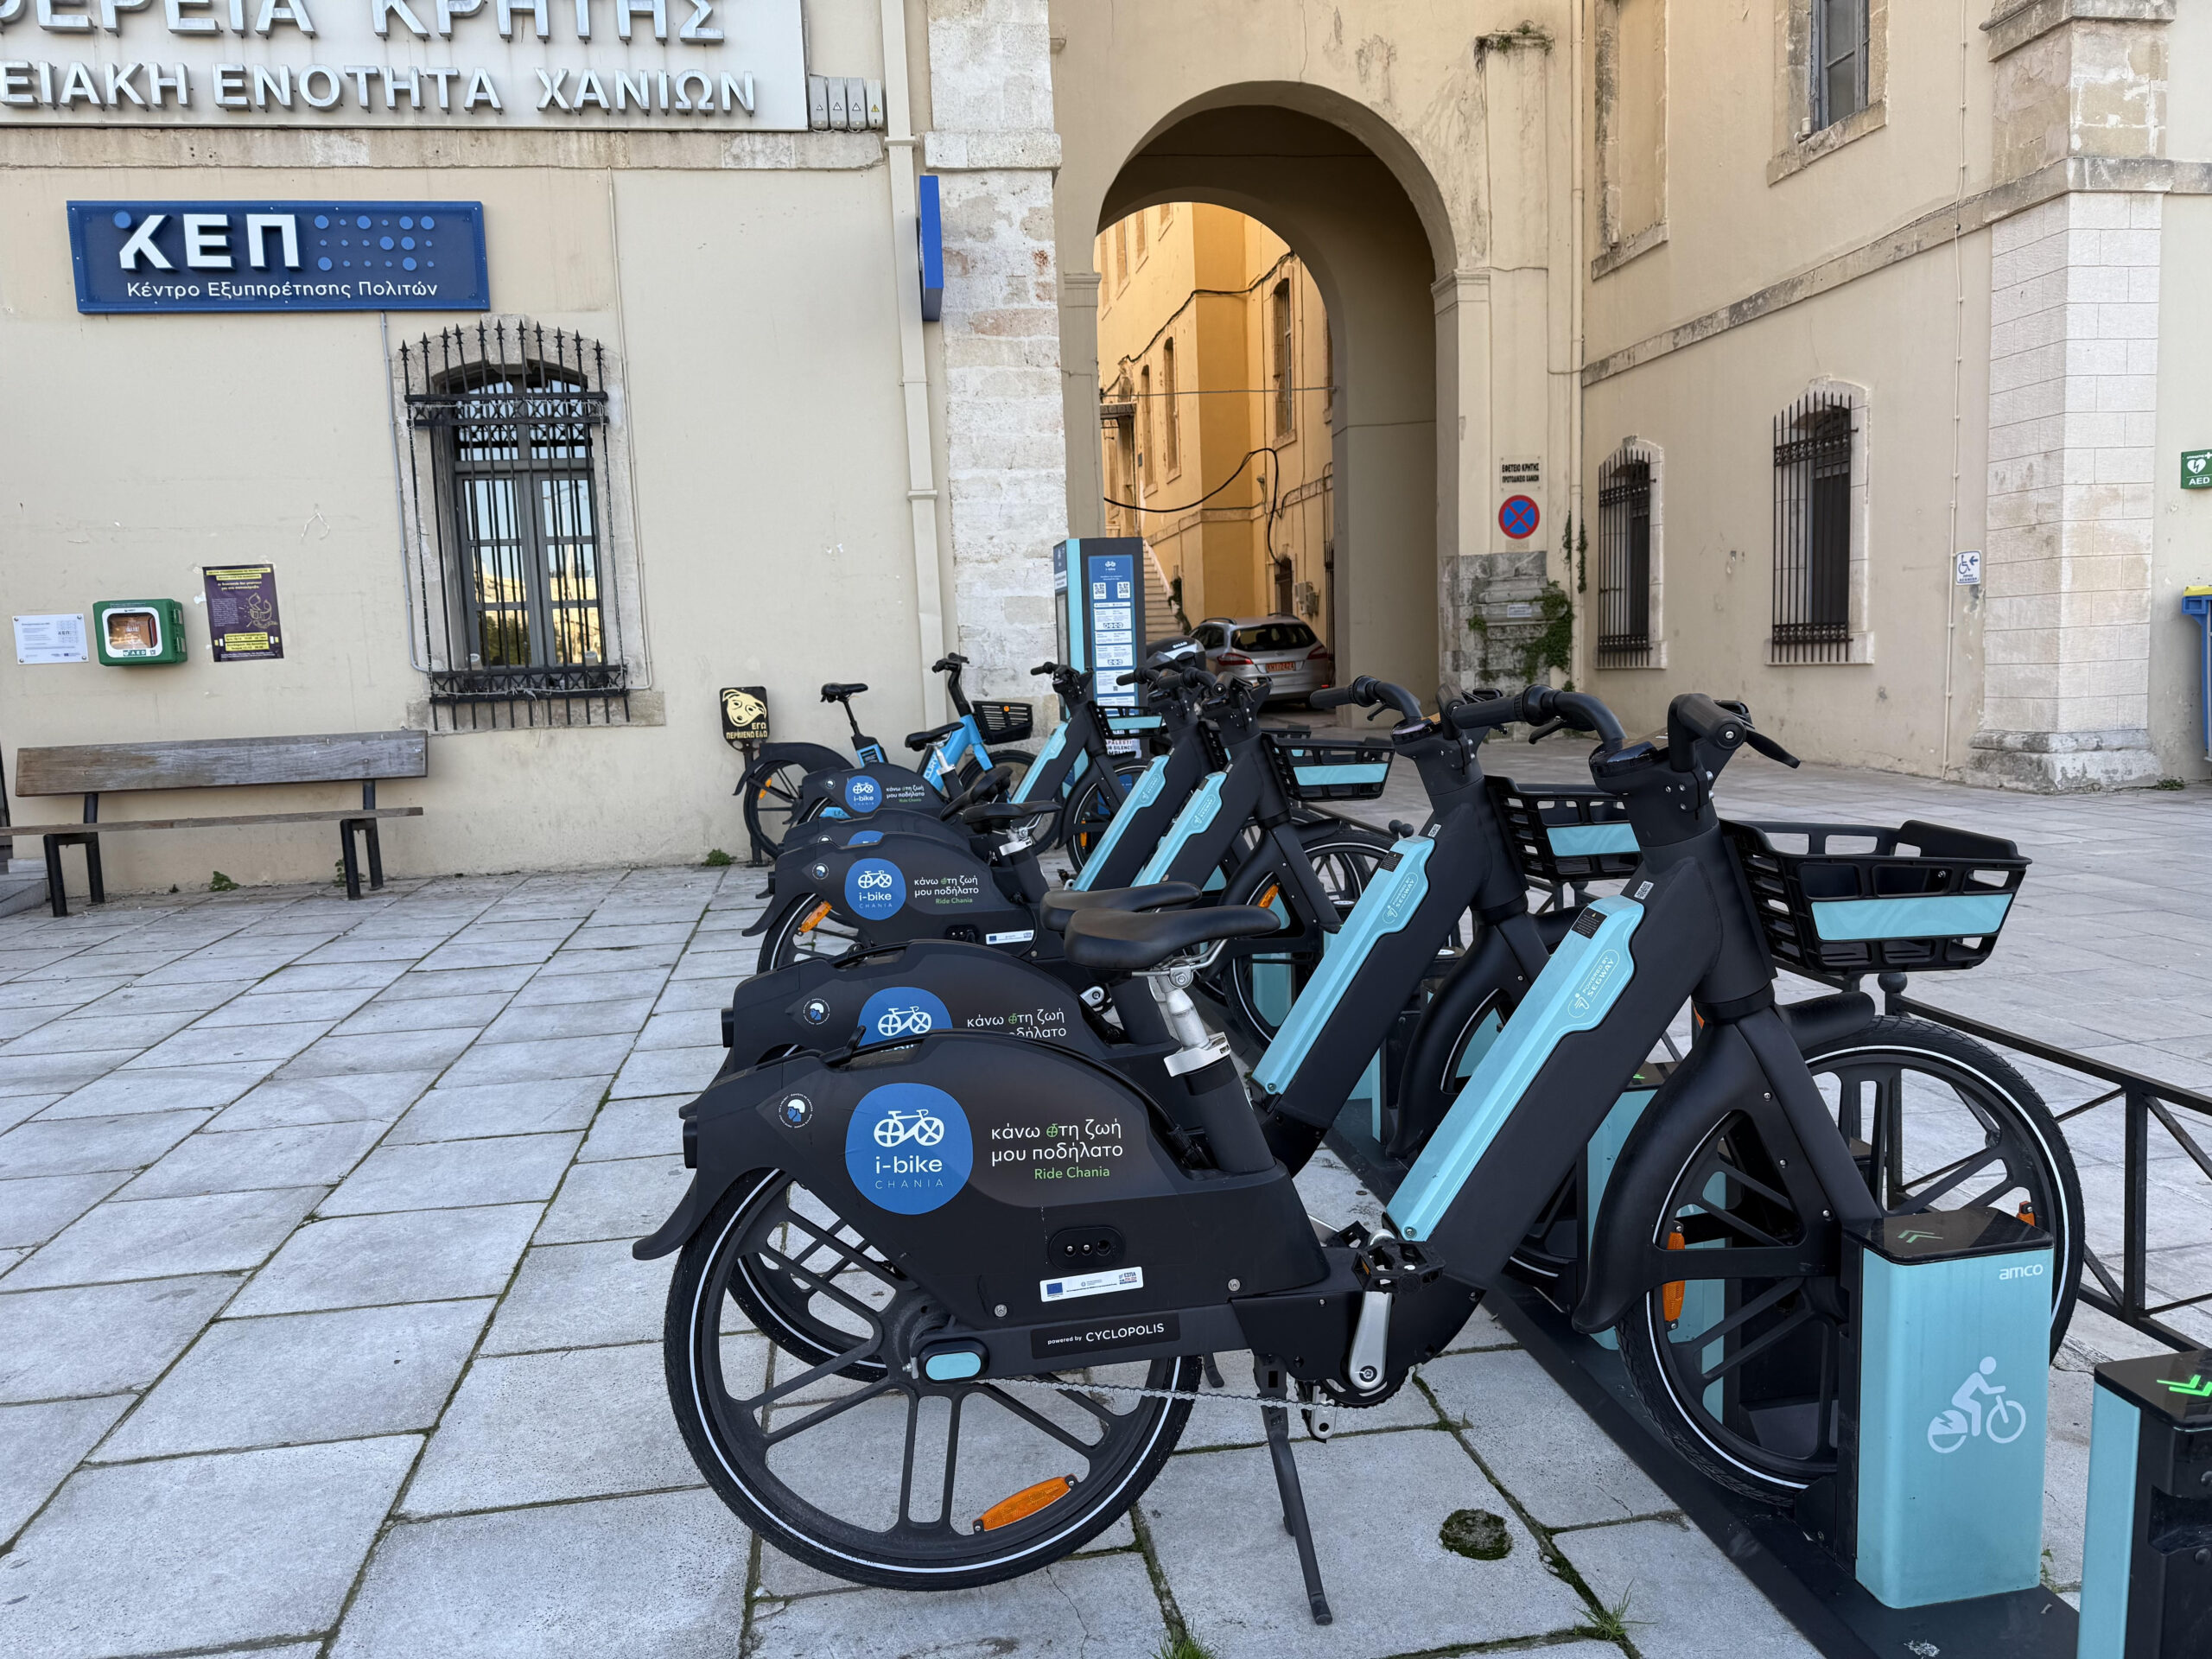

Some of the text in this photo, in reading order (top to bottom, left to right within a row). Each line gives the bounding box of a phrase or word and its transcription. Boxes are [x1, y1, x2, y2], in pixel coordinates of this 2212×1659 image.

[0, 0, 317, 36] ΕΡΕΙΑ
[213, 62, 503, 113] ΕΝΟΤΗΤΑ
[535, 67, 755, 115] ΧΑΝΙΩΝ
[116, 211, 302, 271] ΚΕΠ
[127, 281, 438, 298] Κέντρο Εξυπηρέτησης Πολιτών
[2189, 476, 2210, 486] AED
[726, 731, 755, 740] ΠΕΡΙΜΕΝΩ
[914, 877, 938, 886] κάνω
[960, 875, 978, 886] ζωή
[859, 892, 892, 901] i-bike
[914, 886, 979, 898] μου ποδήλατο
[1395, 879, 1414, 907] SEGWAY
[1582, 956, 1609, 994] POWERED BY
[1587, 958, 1614, 997] SEGWAY
[967, 1014, 1004, 1028] κάνω
[1037, 1007, 1065, 1025] ζωή
[1009, 1026, 1067, 1039] δήλατο
[991, 1122, 1040, 1140] κάνω
[1085, 1118, 1122, 1140] ζωή
[992, 1141, 1123, 1166] μου ποδήλατο
[875, 1155, 943, 1174] i-bike
[1034, 1166, 1110, 1179] Ride Chania
[875, 1179, 944, 1189] CHANIA
[1999, 1263, 2044, 1280] amco
[1047, 1336, 1073, 1345] powered
[1085, 1323, 1165, 1342] CYCLOPOLIS
